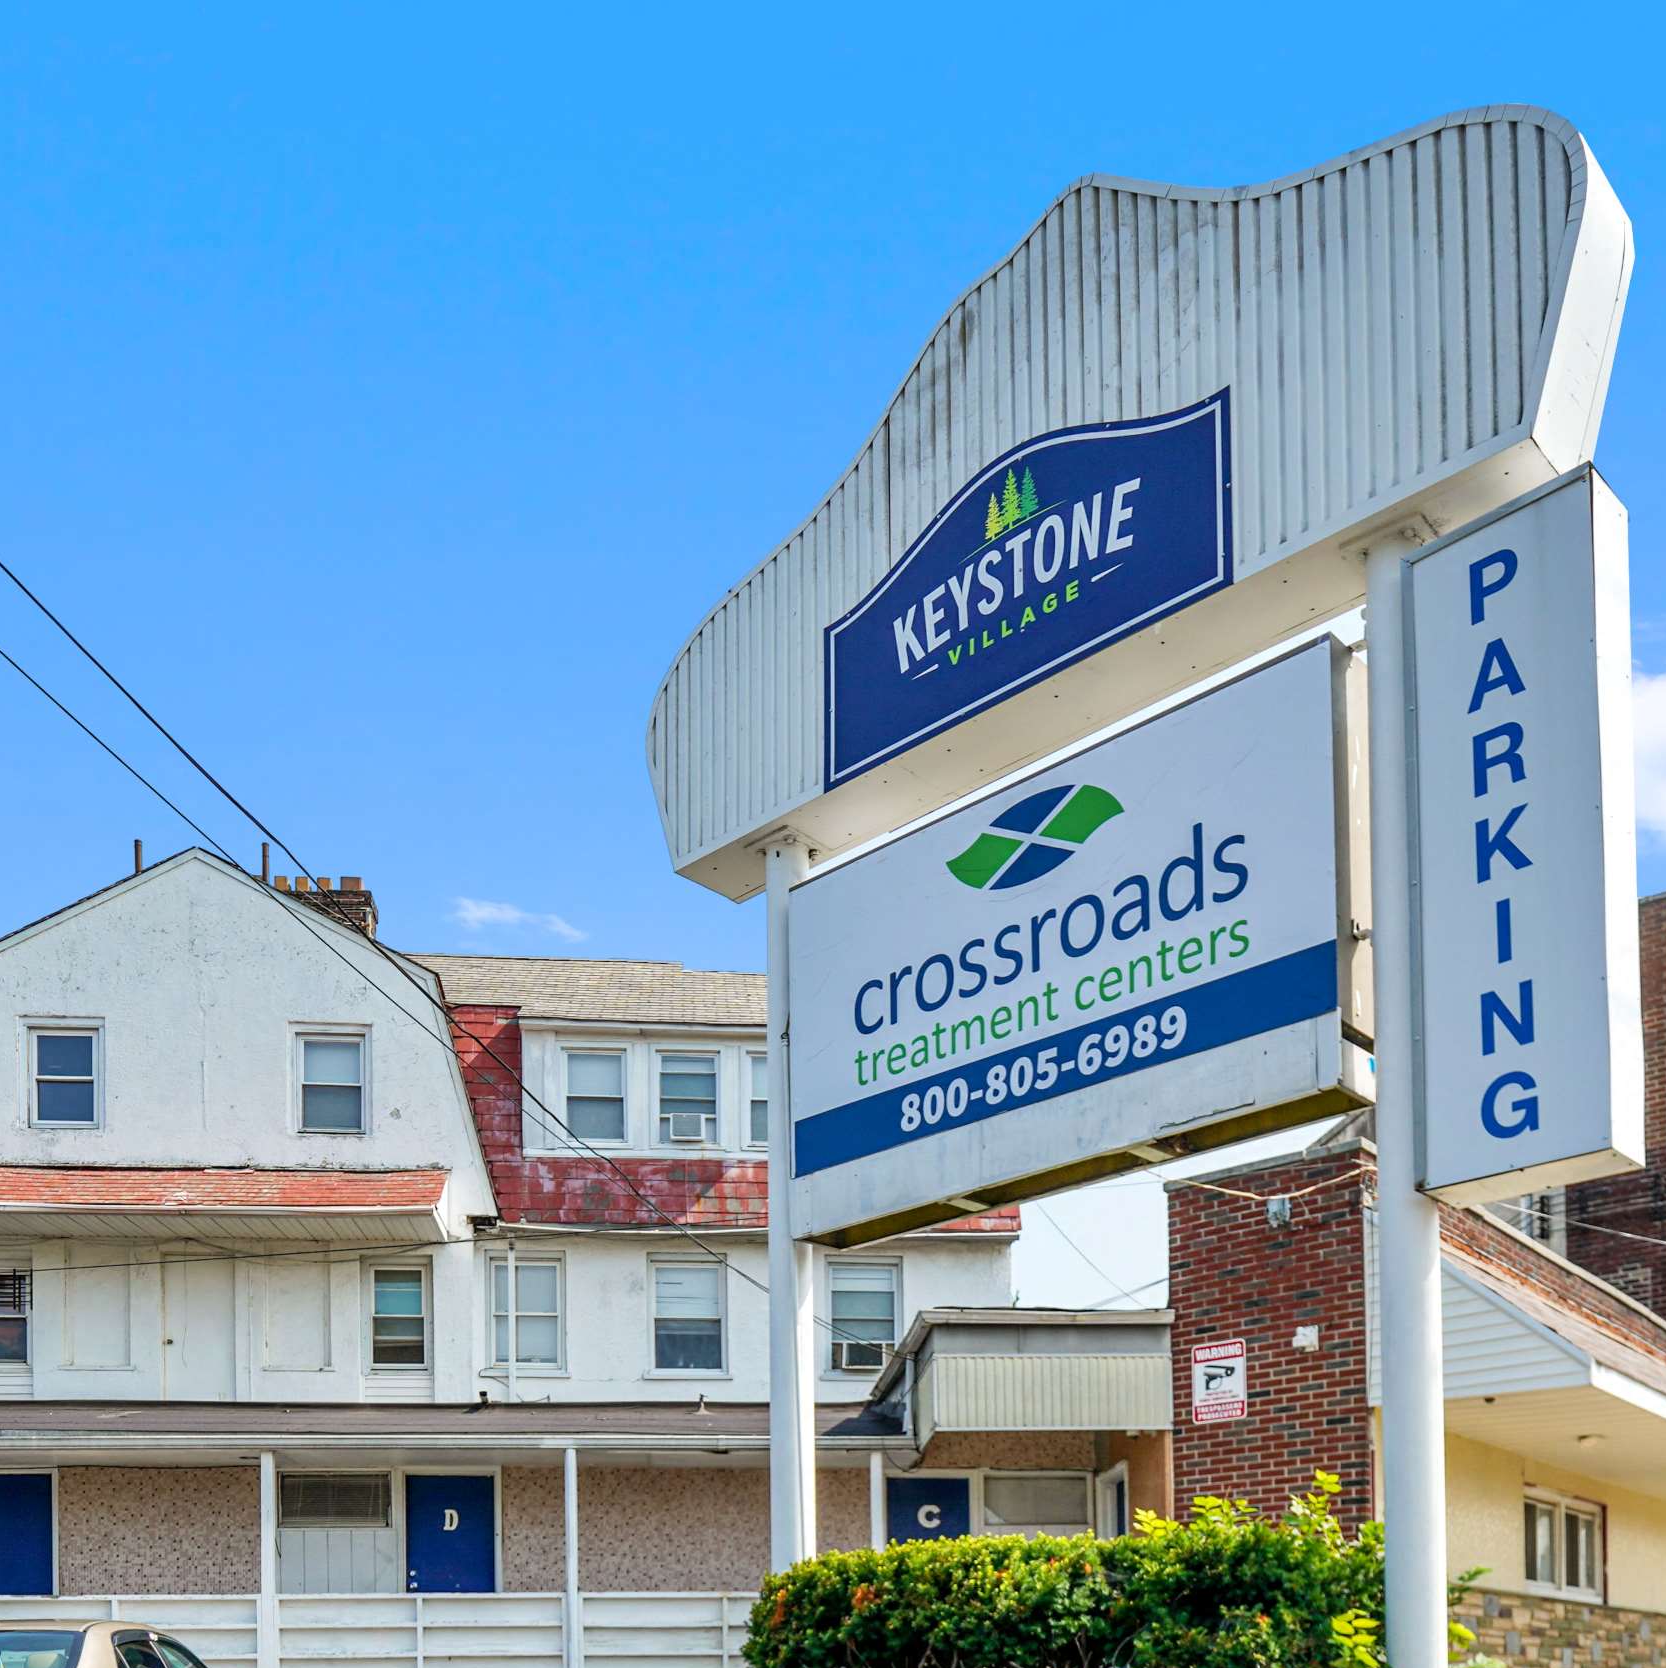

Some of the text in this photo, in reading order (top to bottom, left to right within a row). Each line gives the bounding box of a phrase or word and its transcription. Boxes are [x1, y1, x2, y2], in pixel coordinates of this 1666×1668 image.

[892, 477, 1141, 675] KEYSTONE
[947, 579, 1080, 666] VILLAGE
[1467, 547, 1540, 1139] PARKING
[853, 821, 1250, 1036] crossroads
[854, 918, 1251, 1087] treatment centers
[899, 1004, 1188, 1134] 800-805-6989
[1195, 1343, 1242, 1360] WARNING
[442, 1508, 459, 1532] D
[916, 1504, 941, 1529] C
